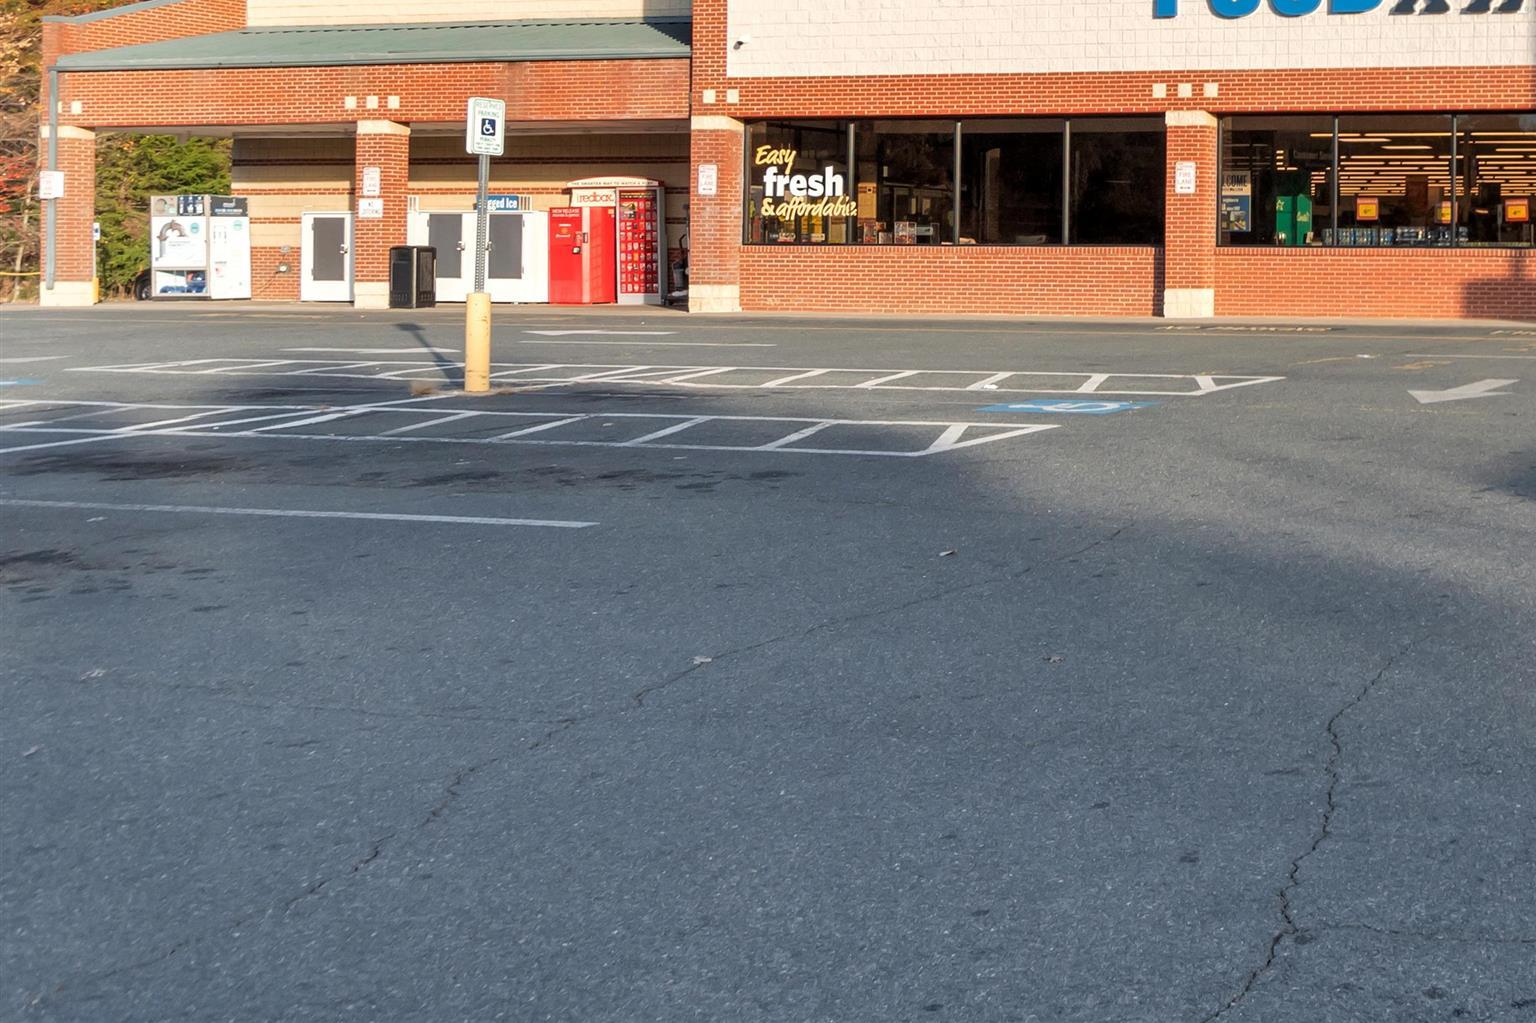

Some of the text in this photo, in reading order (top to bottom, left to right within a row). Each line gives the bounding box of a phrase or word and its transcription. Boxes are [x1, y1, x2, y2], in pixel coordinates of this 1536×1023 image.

[755, 145, 797, 174] Easy
[763, 165, 844, 196] fresh
[506, 197, 517, 208] Ice
[761, 197, 776, 216] &
